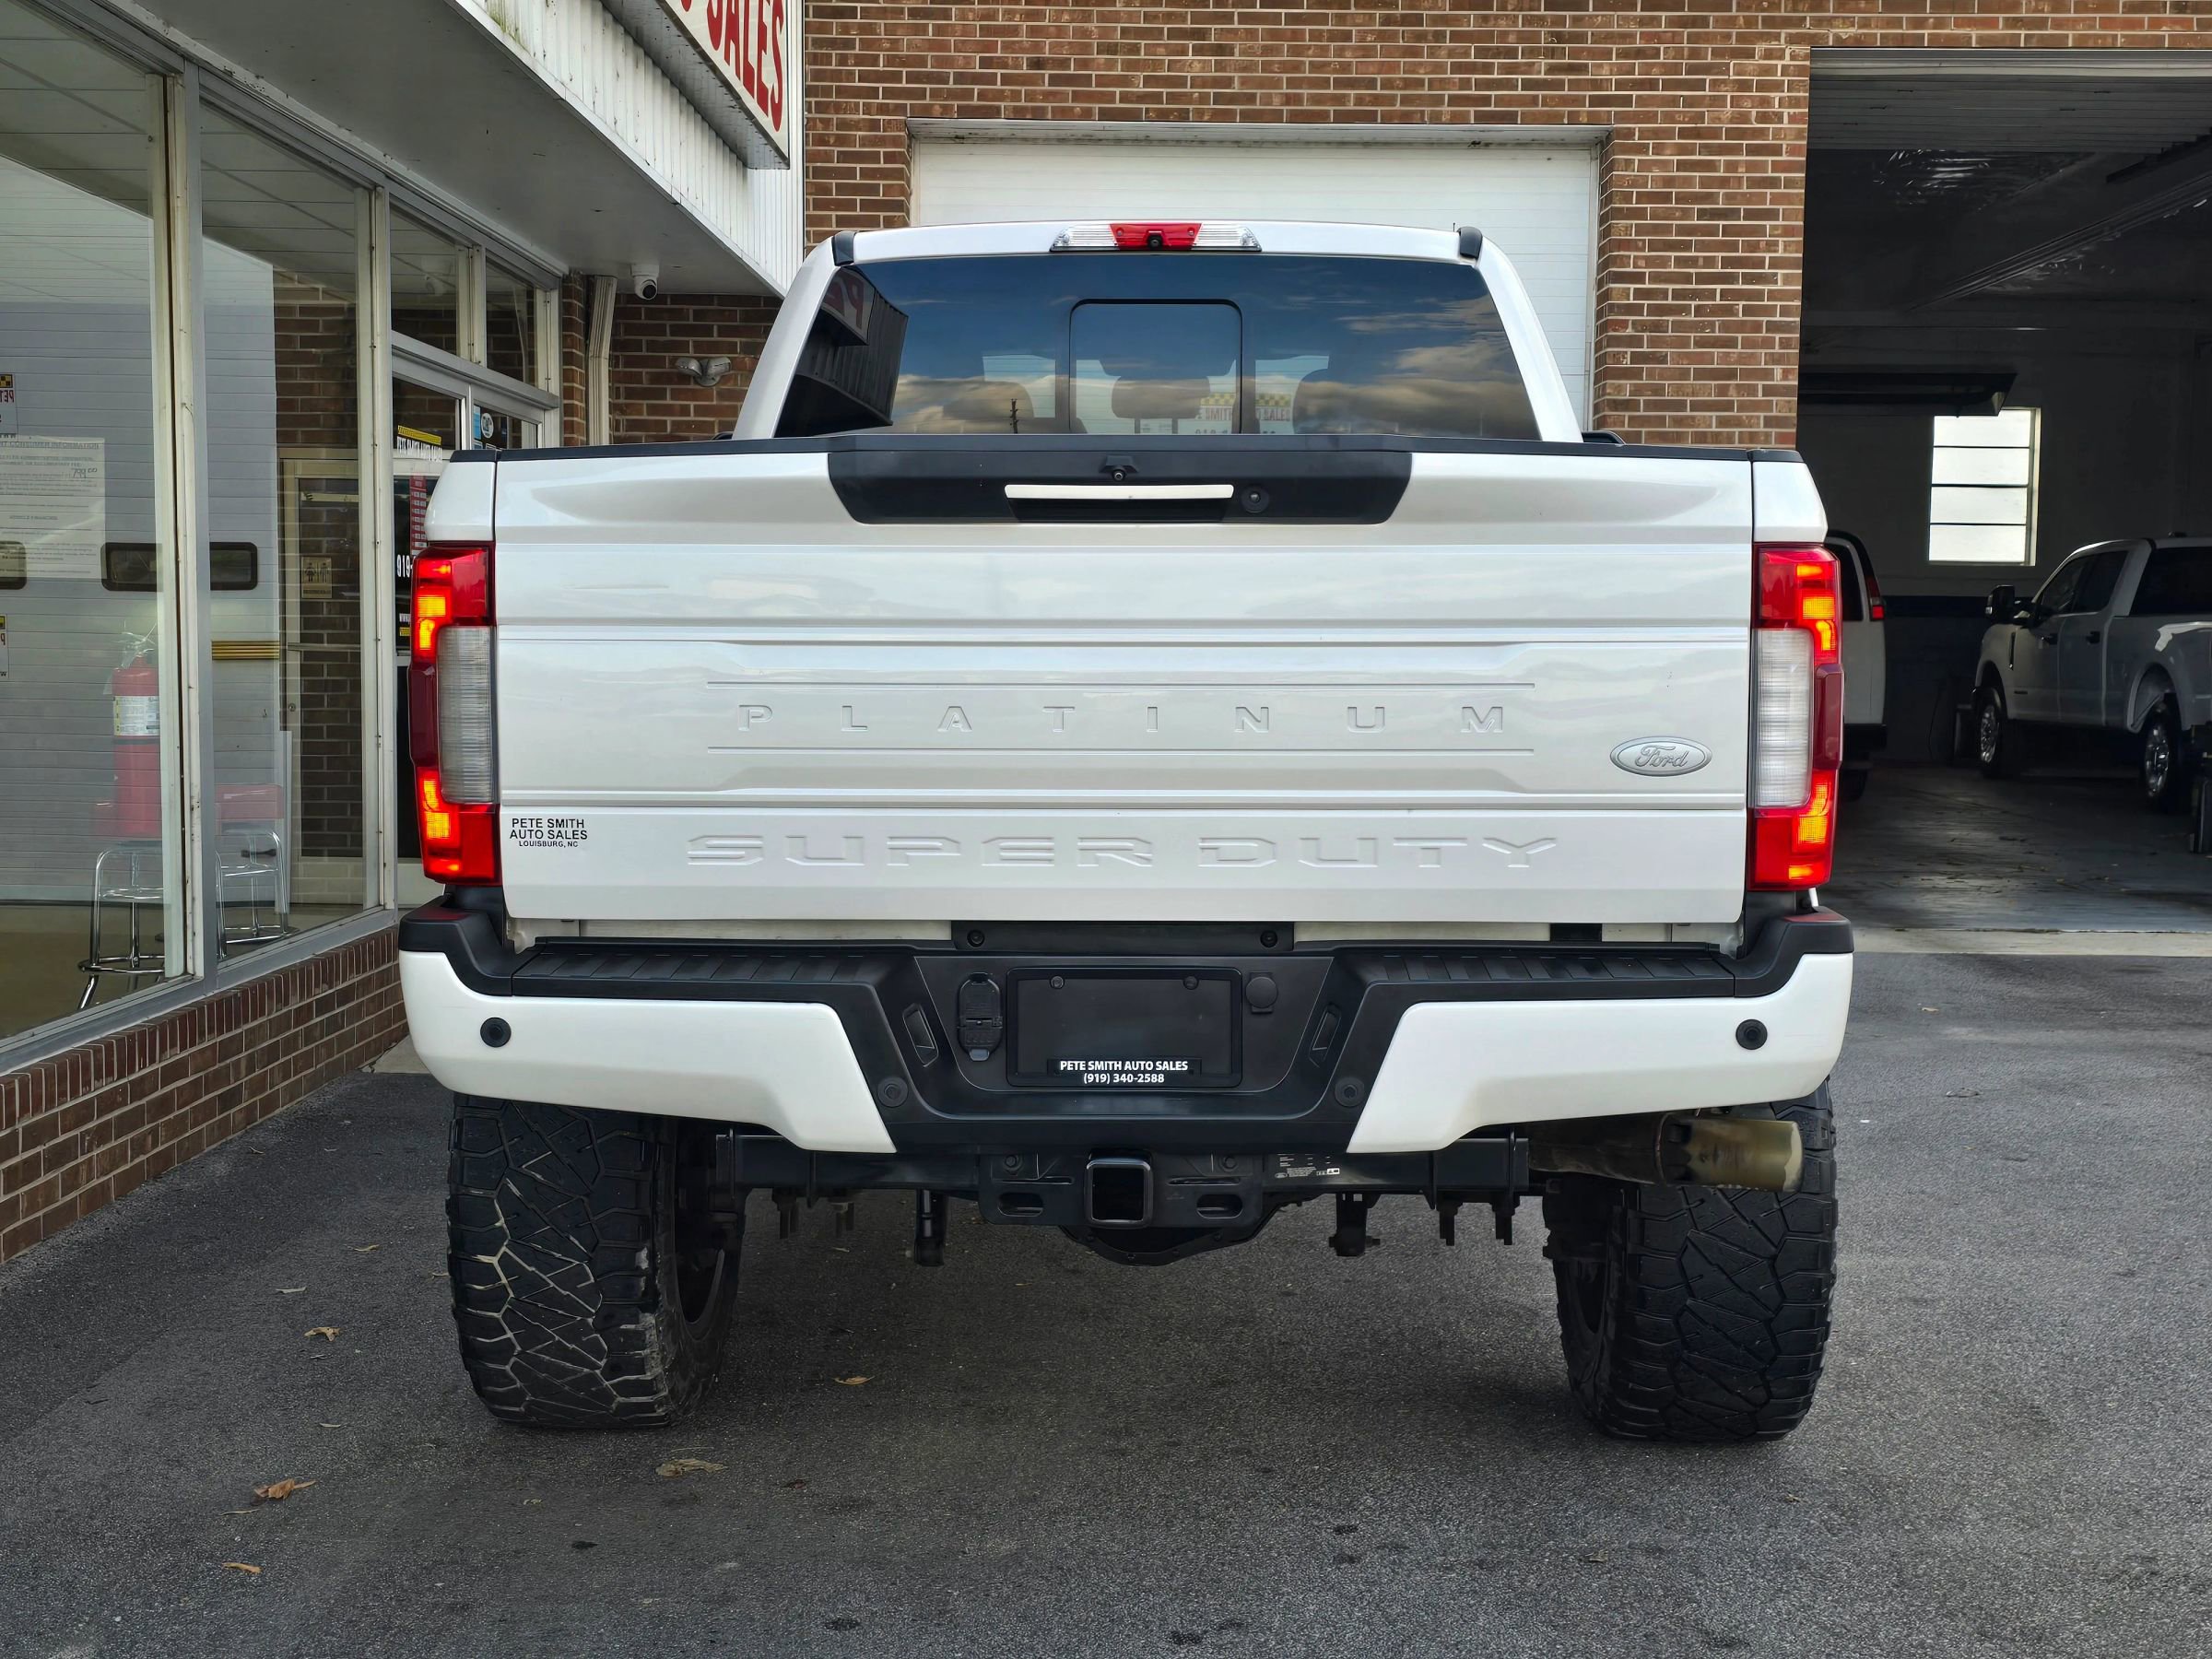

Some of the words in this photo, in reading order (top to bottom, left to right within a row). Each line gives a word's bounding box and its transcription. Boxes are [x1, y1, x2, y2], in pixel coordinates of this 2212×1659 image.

[738, 705, 1503, 734] PLATINUM
[1635, 745, 1689, 767] Ford
[512, 818, 544, 829] PETE
[547, 818, 584, 829] SMITH
[510, 829, 544, 840] AUTO
[547, 830, 588, 841] SALES
[519, 840, 566, 848] LOUISBURG,
[687, 835, 1153, 867] SUPER
[1197, 836, 1558, 868] DUTY
[1060, 1060, 1086, 1071] PETE
[1088, 1060, 1123, 1071] SMITH
[1124, 1060, 1154, 1071] AUTO
[1155, 1060, 1189, 1071] SALES
[1083, 1072, 1111, 1085] (919)
[1112, 1073, 1165, 1083] 340-2588
